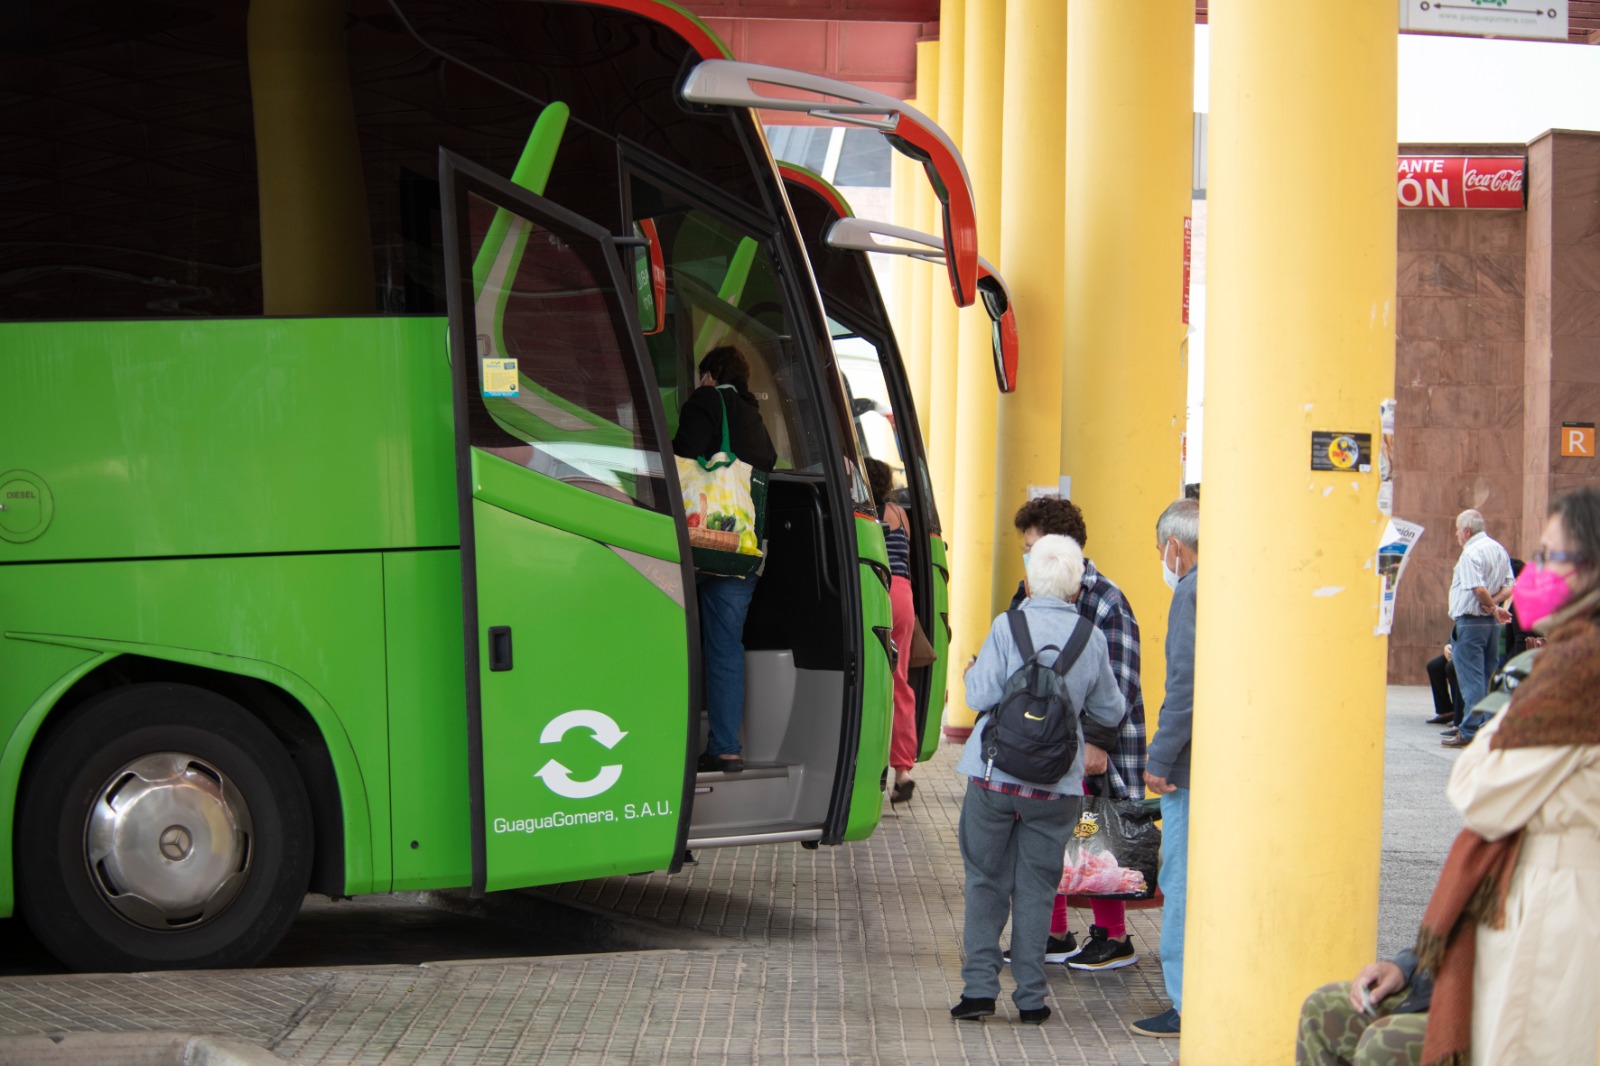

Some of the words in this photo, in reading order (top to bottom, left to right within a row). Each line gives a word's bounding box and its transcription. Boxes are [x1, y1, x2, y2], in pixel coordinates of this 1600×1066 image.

[1569, 430, 1587, 453] R
[6, 491, 36, 499] DIESEL
[494, 810, 619, 834] GuaguaGomera,
[624, 800, 673, 820] S.A.U.
